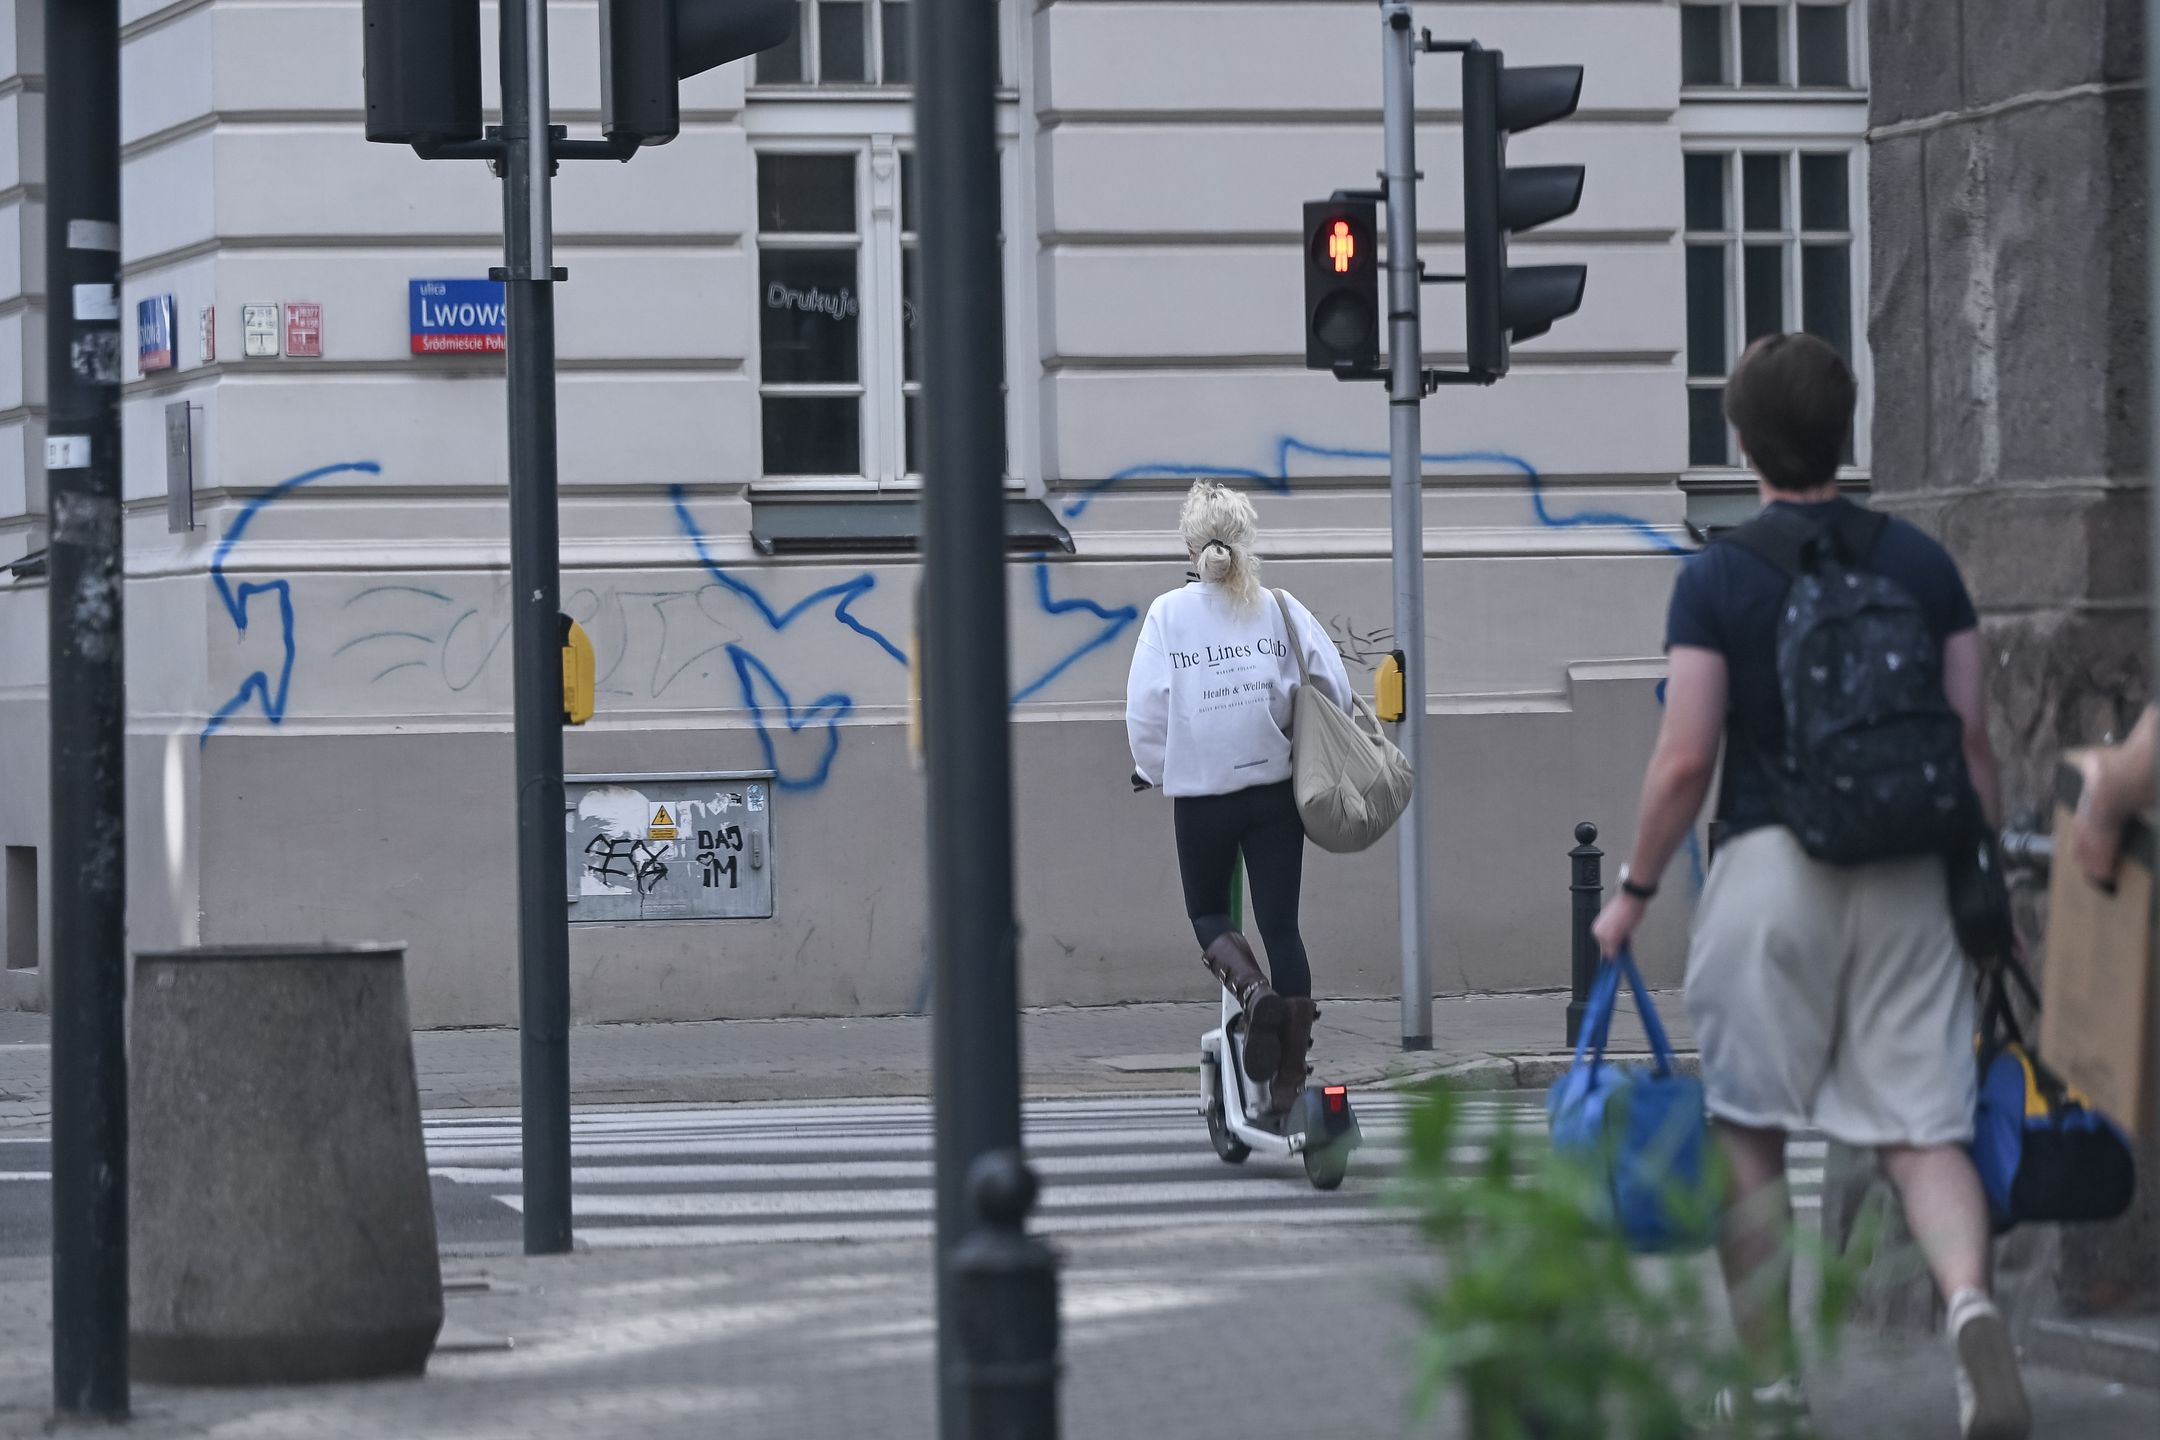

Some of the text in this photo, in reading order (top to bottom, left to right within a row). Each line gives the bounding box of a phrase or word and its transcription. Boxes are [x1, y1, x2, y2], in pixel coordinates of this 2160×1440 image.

[420, 281, 446, 296] ulica
[1169, 638, 1287, 669] The Lines Club
[1203, 687, 1230, 700] Health
[1232, 686, 1240, 695] &
[697, 825, 743, 851] DAJ
